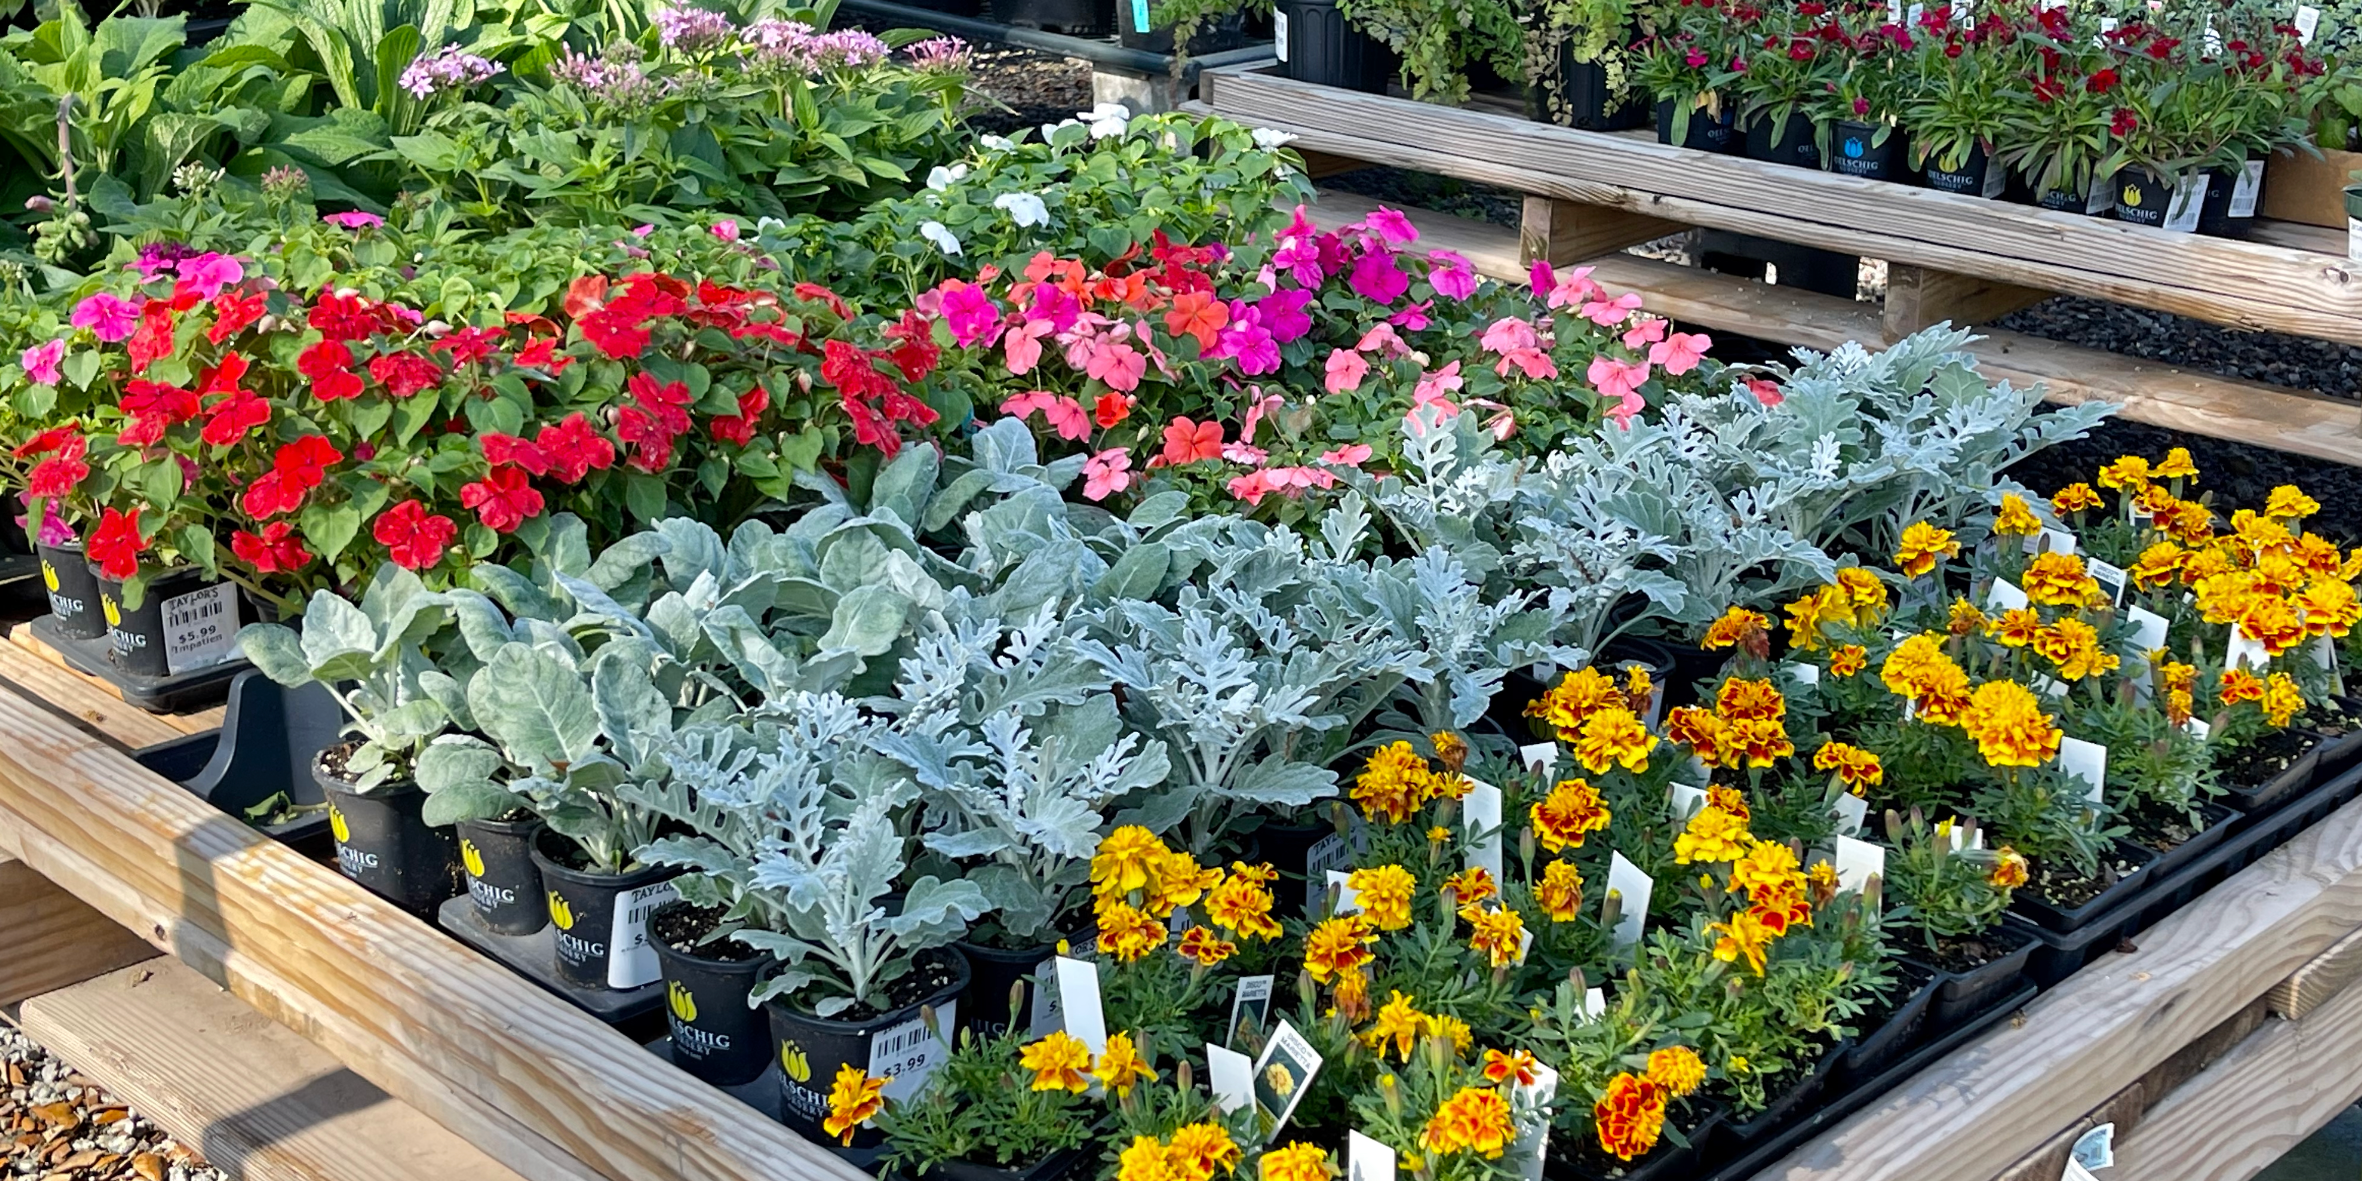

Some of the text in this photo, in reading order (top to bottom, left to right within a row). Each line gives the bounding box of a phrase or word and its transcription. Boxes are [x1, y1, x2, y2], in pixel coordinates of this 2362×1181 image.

[179, 625, 216, 645] $5.99
[631, 881, 675, 904] TAYLO
[883, 1053, 926, 1080] $3.99
